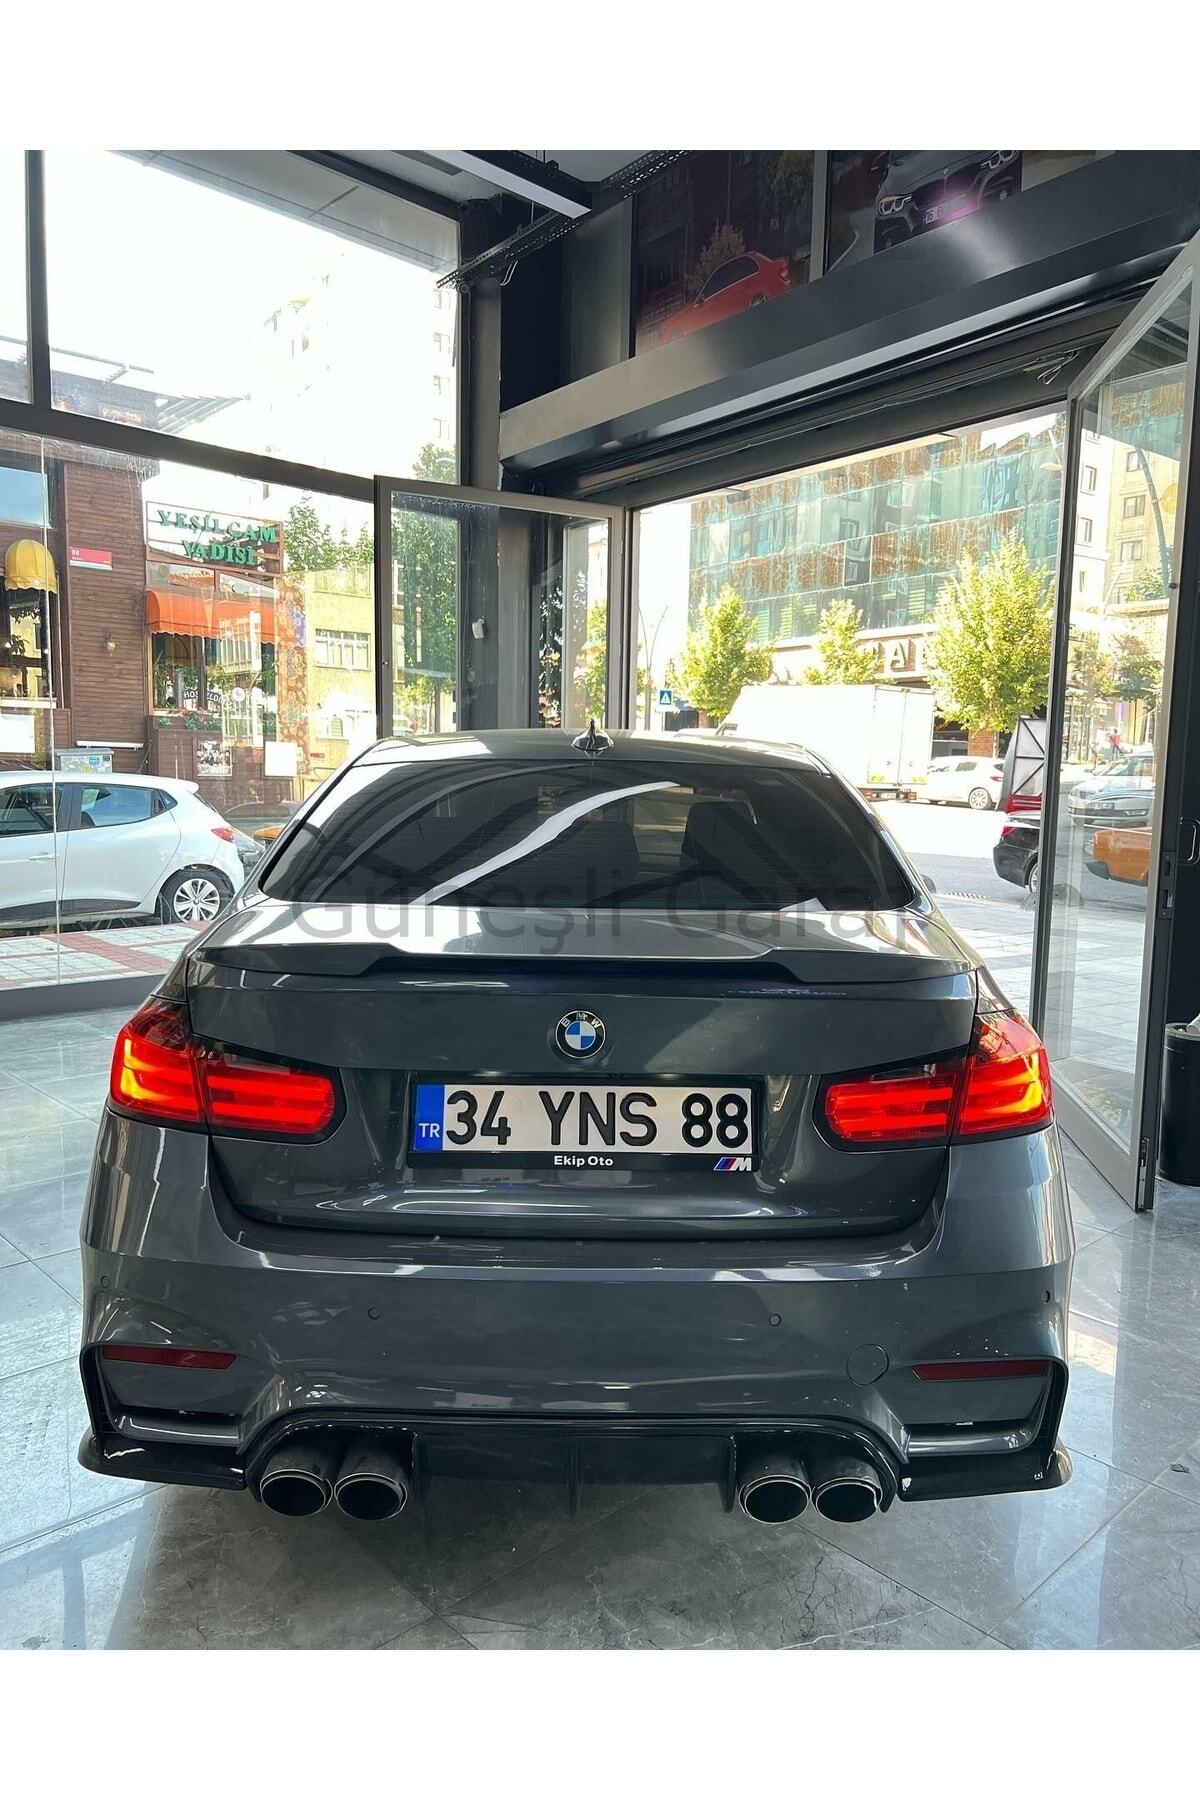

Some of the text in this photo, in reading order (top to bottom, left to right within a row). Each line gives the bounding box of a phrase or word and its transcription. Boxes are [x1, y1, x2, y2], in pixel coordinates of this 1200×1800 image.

[561, 1012, 602, 1028] BMW
[418, 1090, 749, 1149] TR 34 YNS 88
[553, 1155, 614, 1168] Ekip Oto
